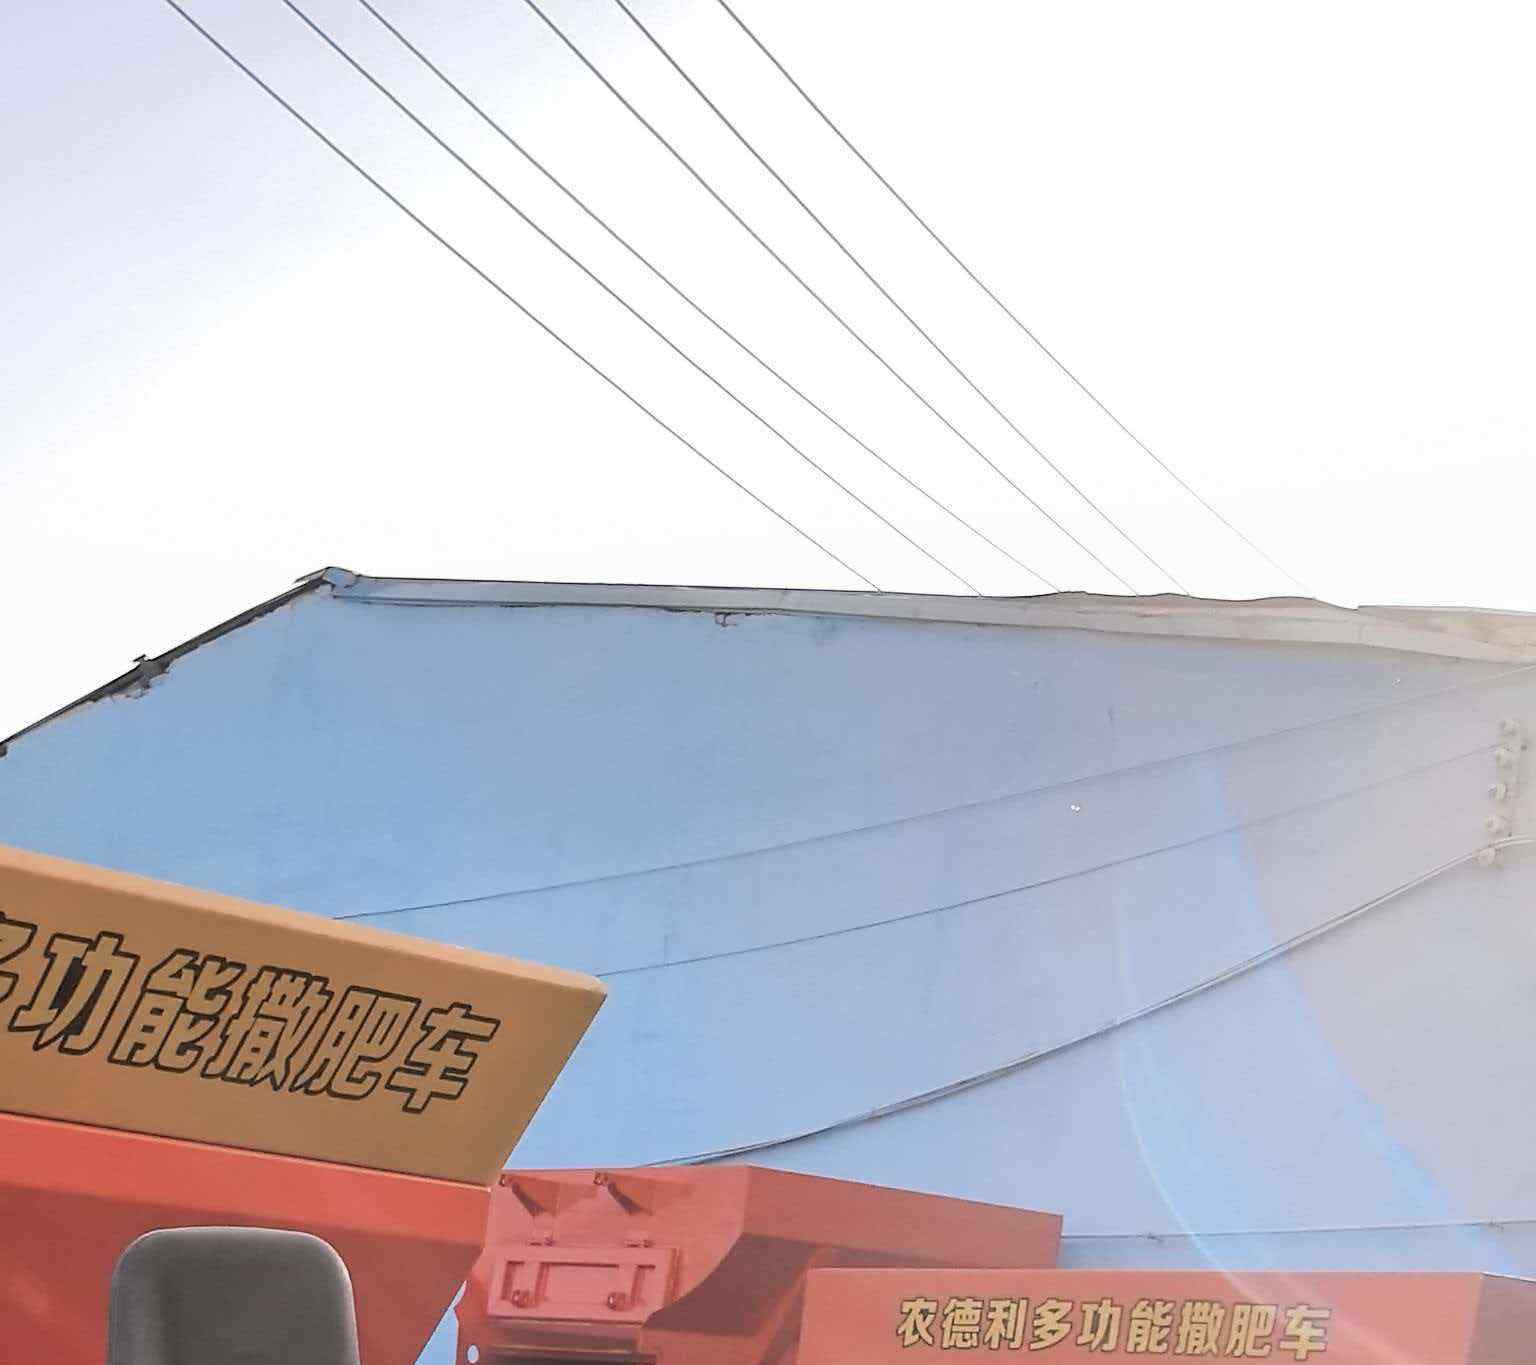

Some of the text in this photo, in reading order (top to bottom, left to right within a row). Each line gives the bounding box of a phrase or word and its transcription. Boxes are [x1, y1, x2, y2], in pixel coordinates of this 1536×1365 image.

[896, 1296, 1332, 1361] 农德利多功能撒肥车
